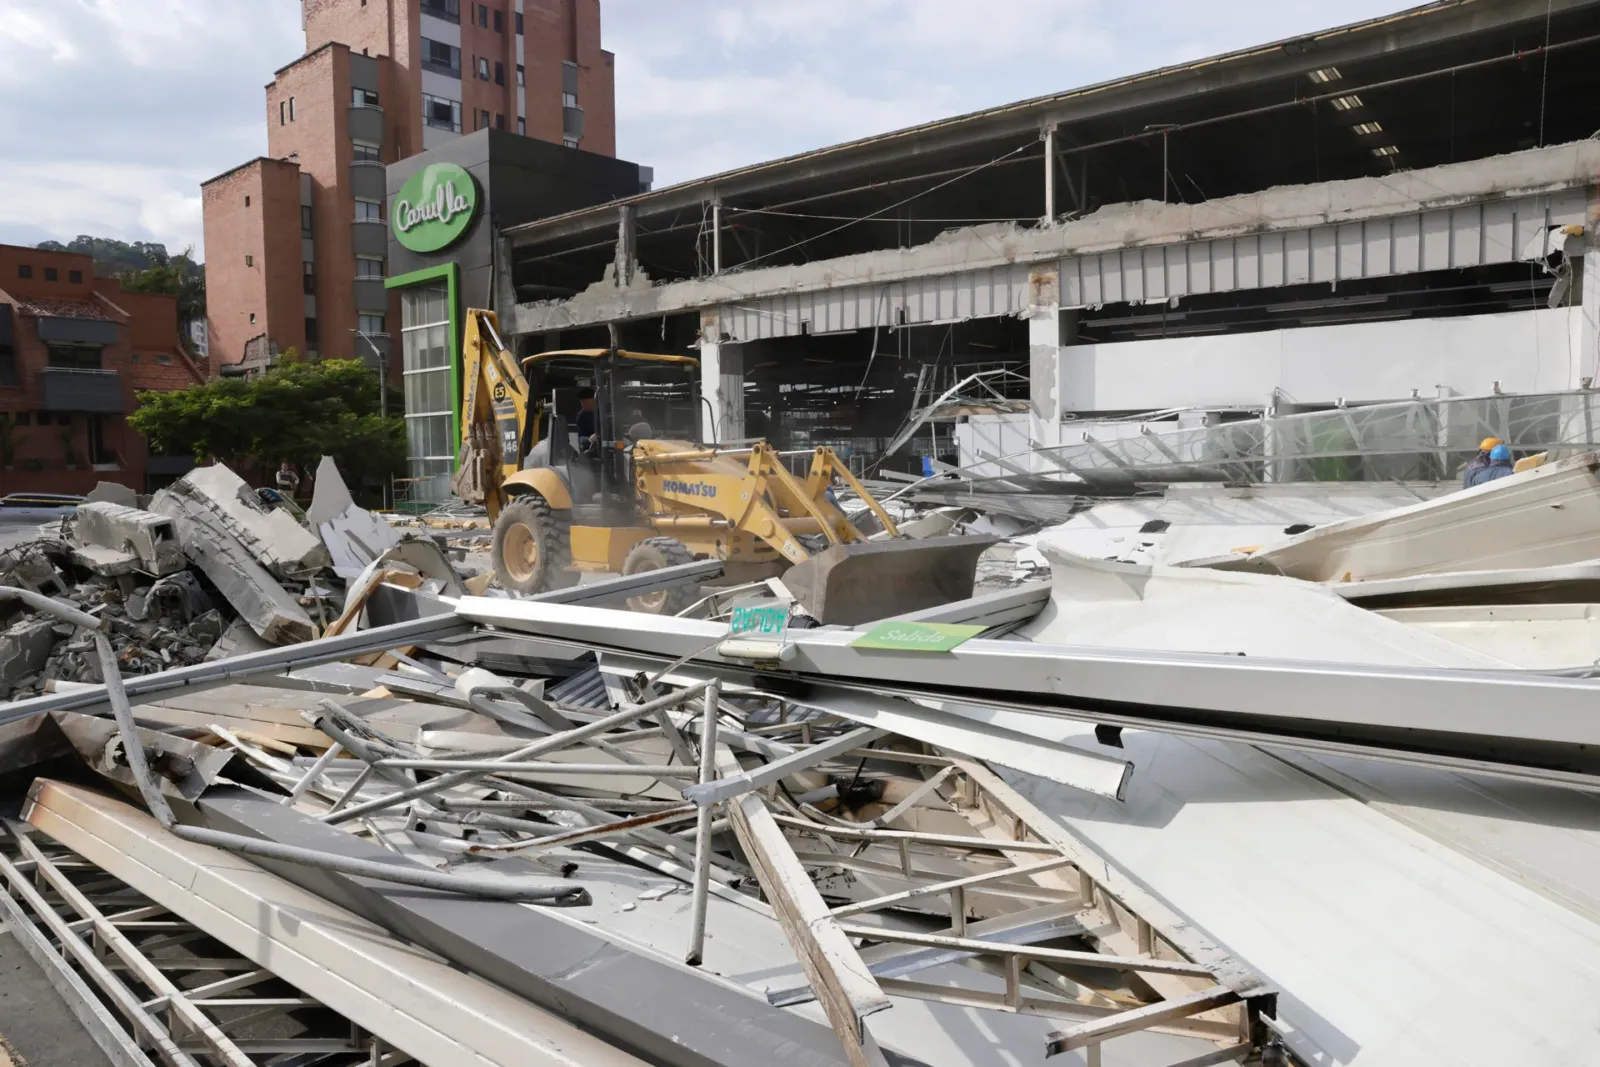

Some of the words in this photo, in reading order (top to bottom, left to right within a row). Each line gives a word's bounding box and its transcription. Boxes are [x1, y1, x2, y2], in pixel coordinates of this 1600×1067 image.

[397, 180, 468, 232] Carulla
[467, 360, 477, 420] KOMA
[504, 431, 516, 440] WB
[502, 441, 518, 452] 146
[663, 480, 717, 498] KOMATSU
[880, 629, 945, 643] Salida
